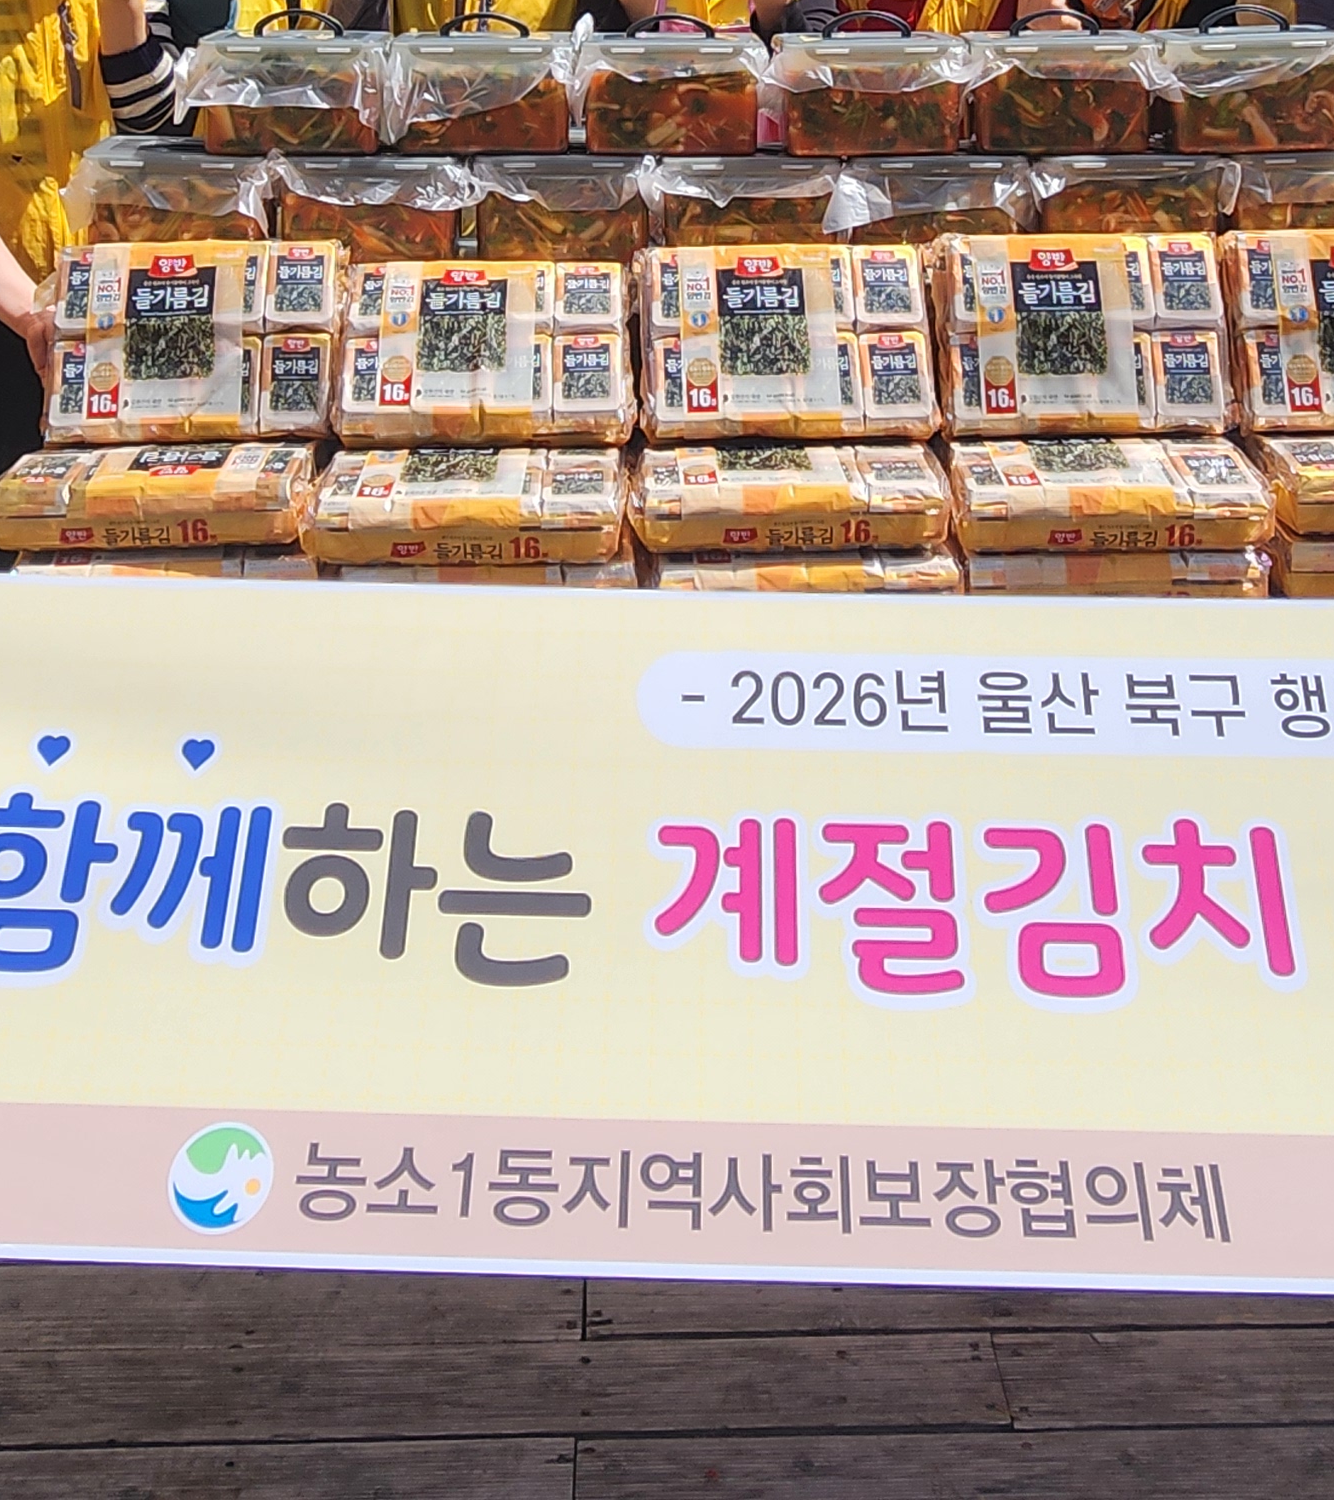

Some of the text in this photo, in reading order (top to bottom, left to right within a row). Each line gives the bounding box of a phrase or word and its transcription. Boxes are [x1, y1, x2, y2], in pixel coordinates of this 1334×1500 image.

[158, 257, 187, 274] 양반
[743, 257, 772, 273] 양반
[1037, 252, 1066, 266] 양반
[451, 270, 478, 282] 양반
[131, 284, 210, 311] 들기름김
[424, 291, 503, 311] 들기름김
[723, 286, 800, 309] 들기름김
[1018, 280, 1096, 305] 들기름김
[102, 527, 170, 545] 들기름김
[765, 527, 834, 545] 들기름김
[1089, 530, 1158, 547] 들기름김
[433, 542, 503, 560] 들기름김
[731, 670, 949, 733] 2026년
[977, 671, 1100, 735] 울산
[1125, 673, 1246, 737] 북구
[655, 817, 1296, 998] 계절김치
[296, 1142, 1232, 1244] 농소1동지역사회보장협의체
